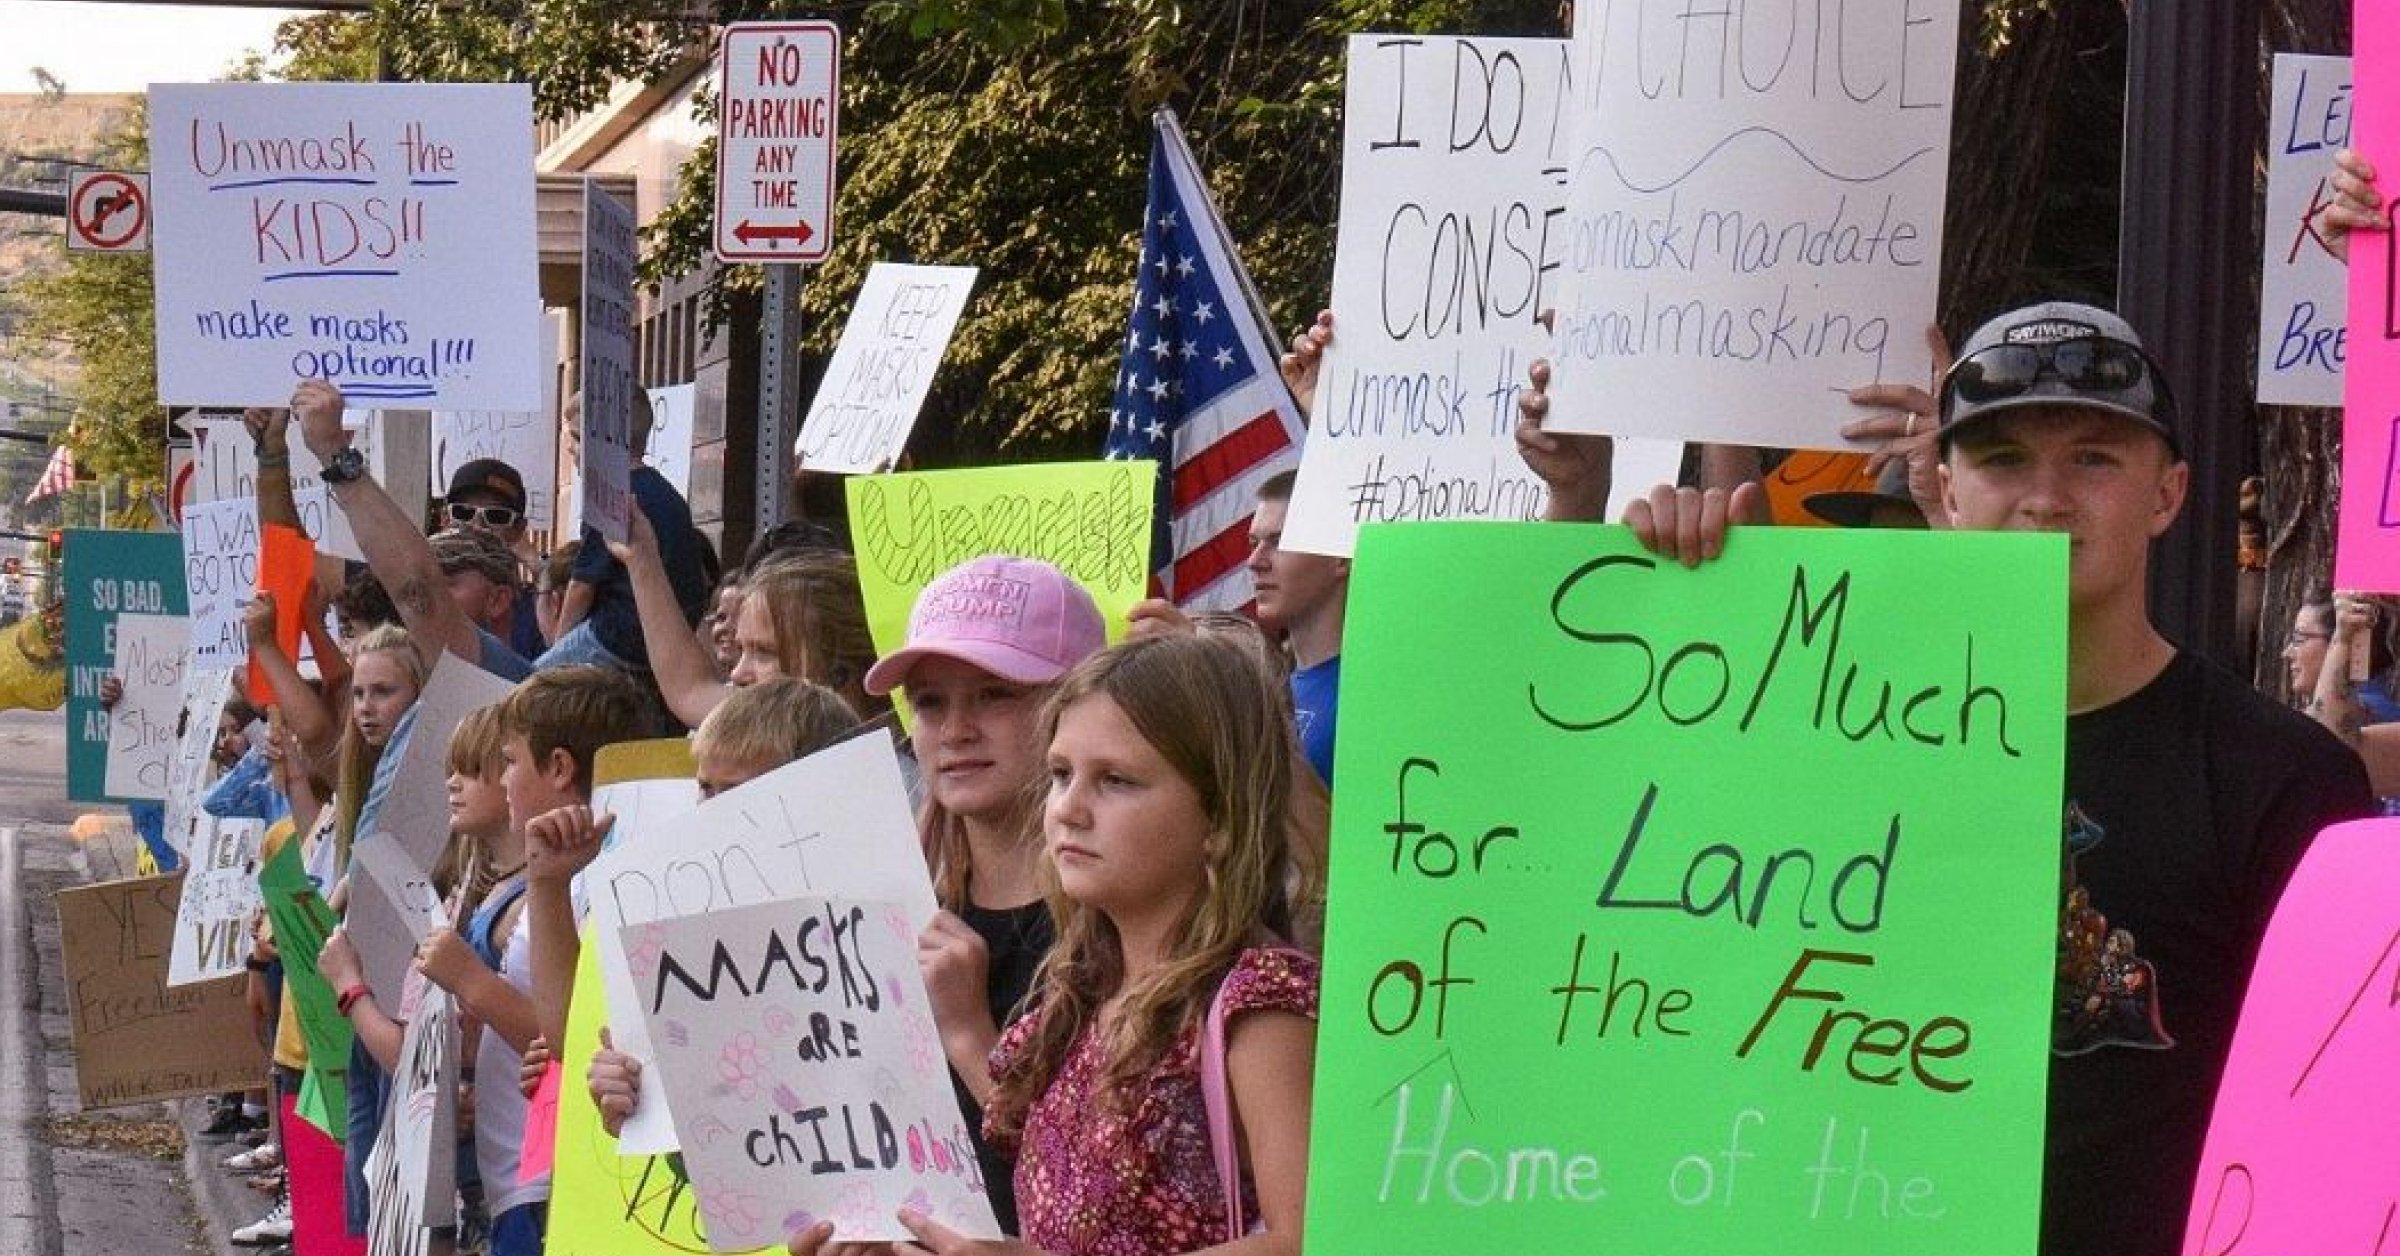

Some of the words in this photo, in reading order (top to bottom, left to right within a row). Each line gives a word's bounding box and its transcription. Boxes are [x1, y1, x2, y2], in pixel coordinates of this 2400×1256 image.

[758, 44, 800, 87] NO
[1370, 38, 1424, 151] I
[1450, 38, 1524, 154] DO
[192, 117, 377, 178] Unmask
[397, 121, 457, 172] the
[730, 98, 826, 139] PARKING
[755, 145, 797, 173] ANY
[751, 180, 798, 209] TIME
[252, 198, 427, 267] KIDS!!
[1381, 201, 1567, 341] CONSE
[197, 300, 293, 340] make
[311, 309, 409, 343] masks
[878, 283, 950, 342] KEEP
[2274, 302, 2347, 373] BRE
[293, 339, 475, 382] optional!!!
[1486, 348, 1523, 437] th
[1348, 453, 1543, 524] #optionalma
[211, 511, 257, 552] WA
[859, 466, 1148, 592] Unmask
[92, 577, 118, 611] SO
[85, 710, 109, 742] AR
[1596, 783, 1901, 933] Land
[653, 900, 881, 1015] MASKS
[1367, 916, 1486, 1041] of
[1552, 933, 1693, 1046] the
[1736, 947, 1975, 1094] Free
[1376, 1082, 1605, 1209] Home
[1670, 1110, 1766, 1209] of
[1805, 1116, 1948, 1223] the
